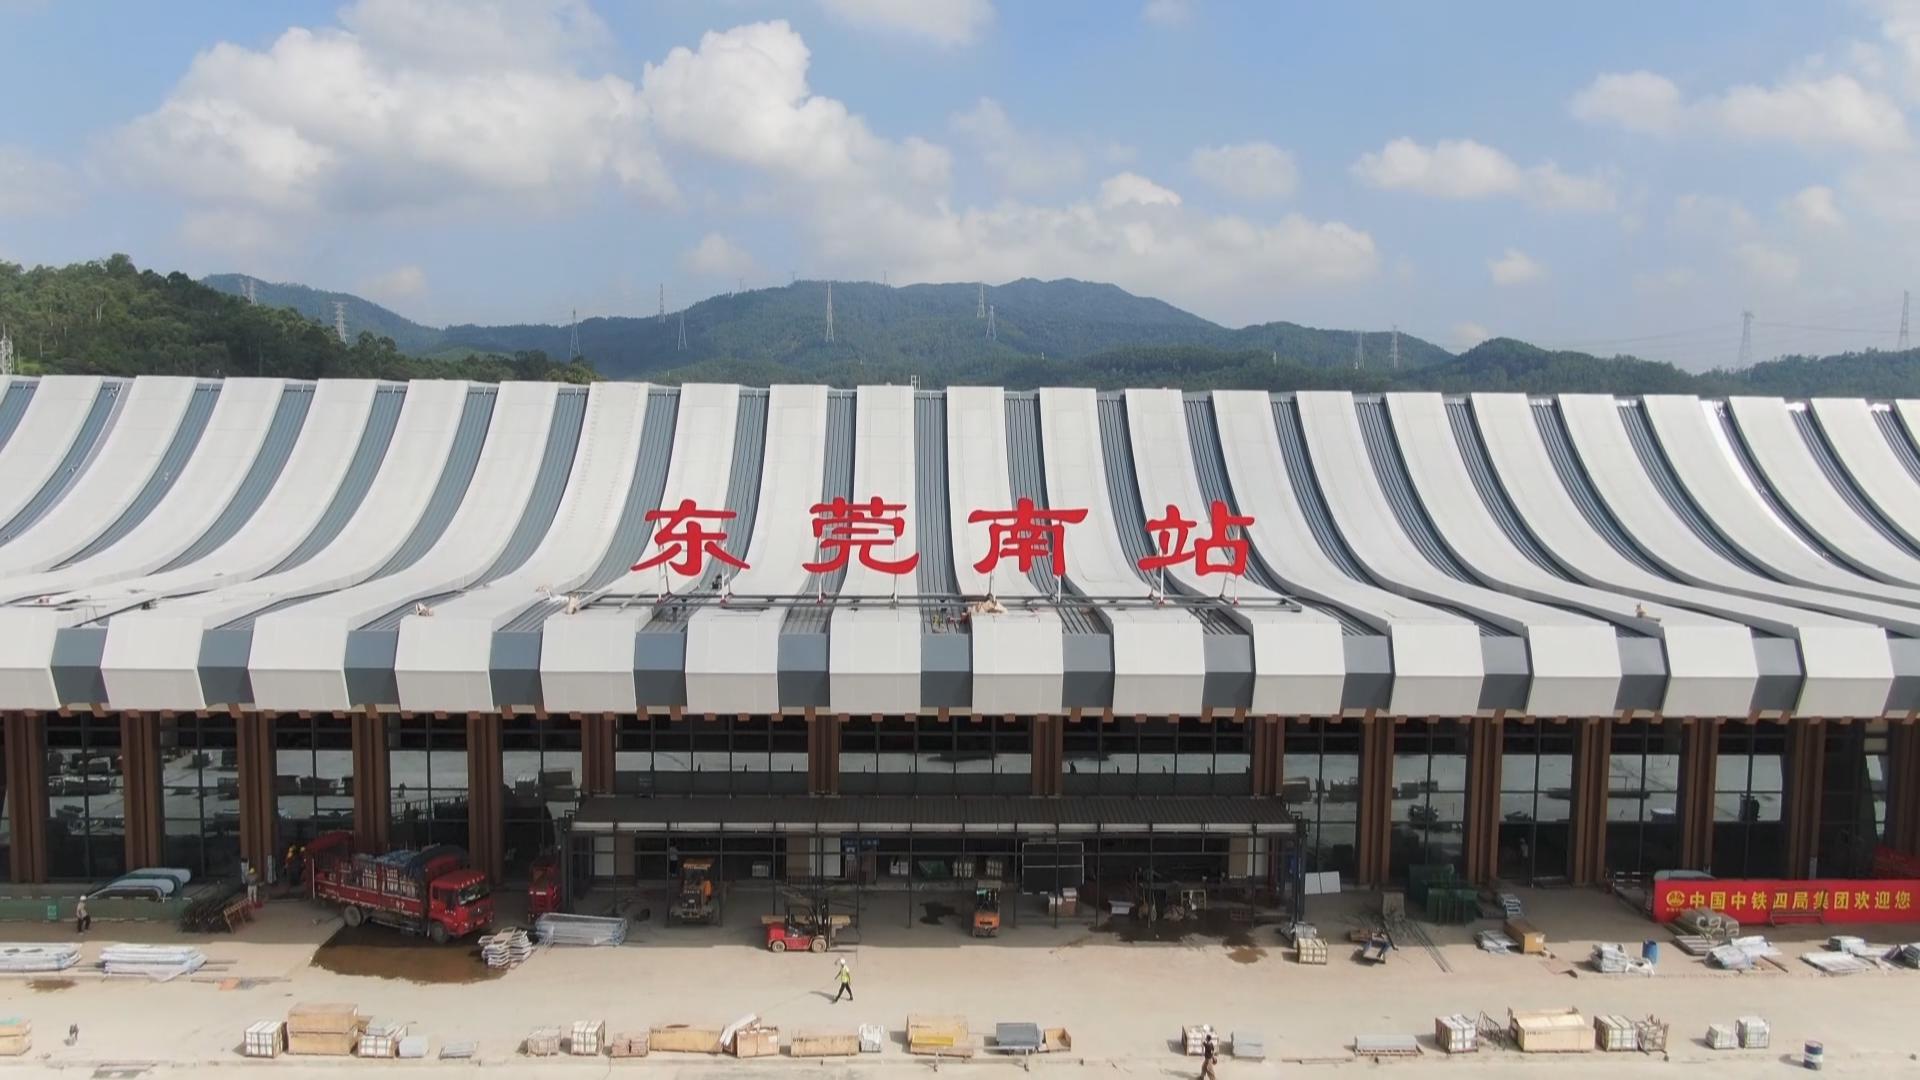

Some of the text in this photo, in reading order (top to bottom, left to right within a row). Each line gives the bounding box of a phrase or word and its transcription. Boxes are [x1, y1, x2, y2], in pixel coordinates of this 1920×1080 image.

[632, 496, 1255, 576] 东莞南站
[1689, 890, 1911, 912] 中国中铁四局集团欢迎您
